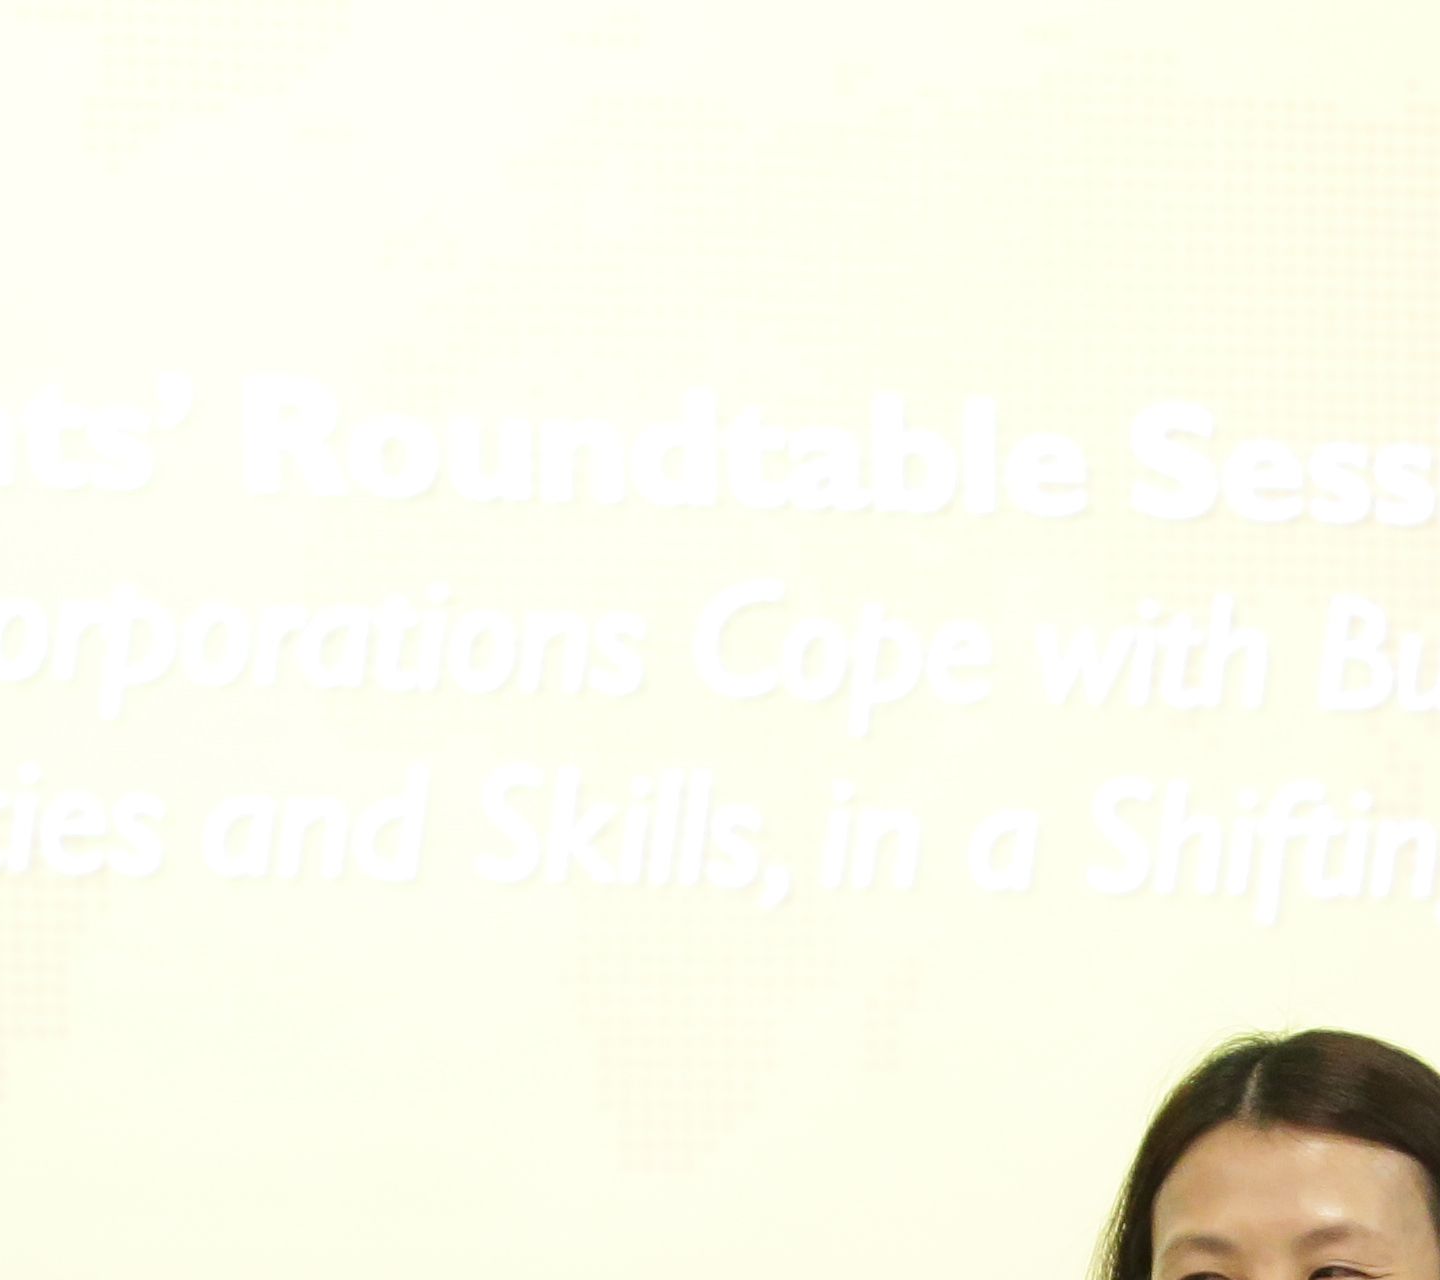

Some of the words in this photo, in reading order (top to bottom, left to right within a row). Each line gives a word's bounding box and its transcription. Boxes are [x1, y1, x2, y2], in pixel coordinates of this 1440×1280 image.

[240, 371, 1089, 518] Roundtable
[691, 577, 995, 739] Cope
[1033, 593, 1271, 711] with
[202, 757, 431, 884] and
[473, 760, 791, 909] Skills,
[820, 776, 923, 893] in
[967, 805, 1041, 893] a
